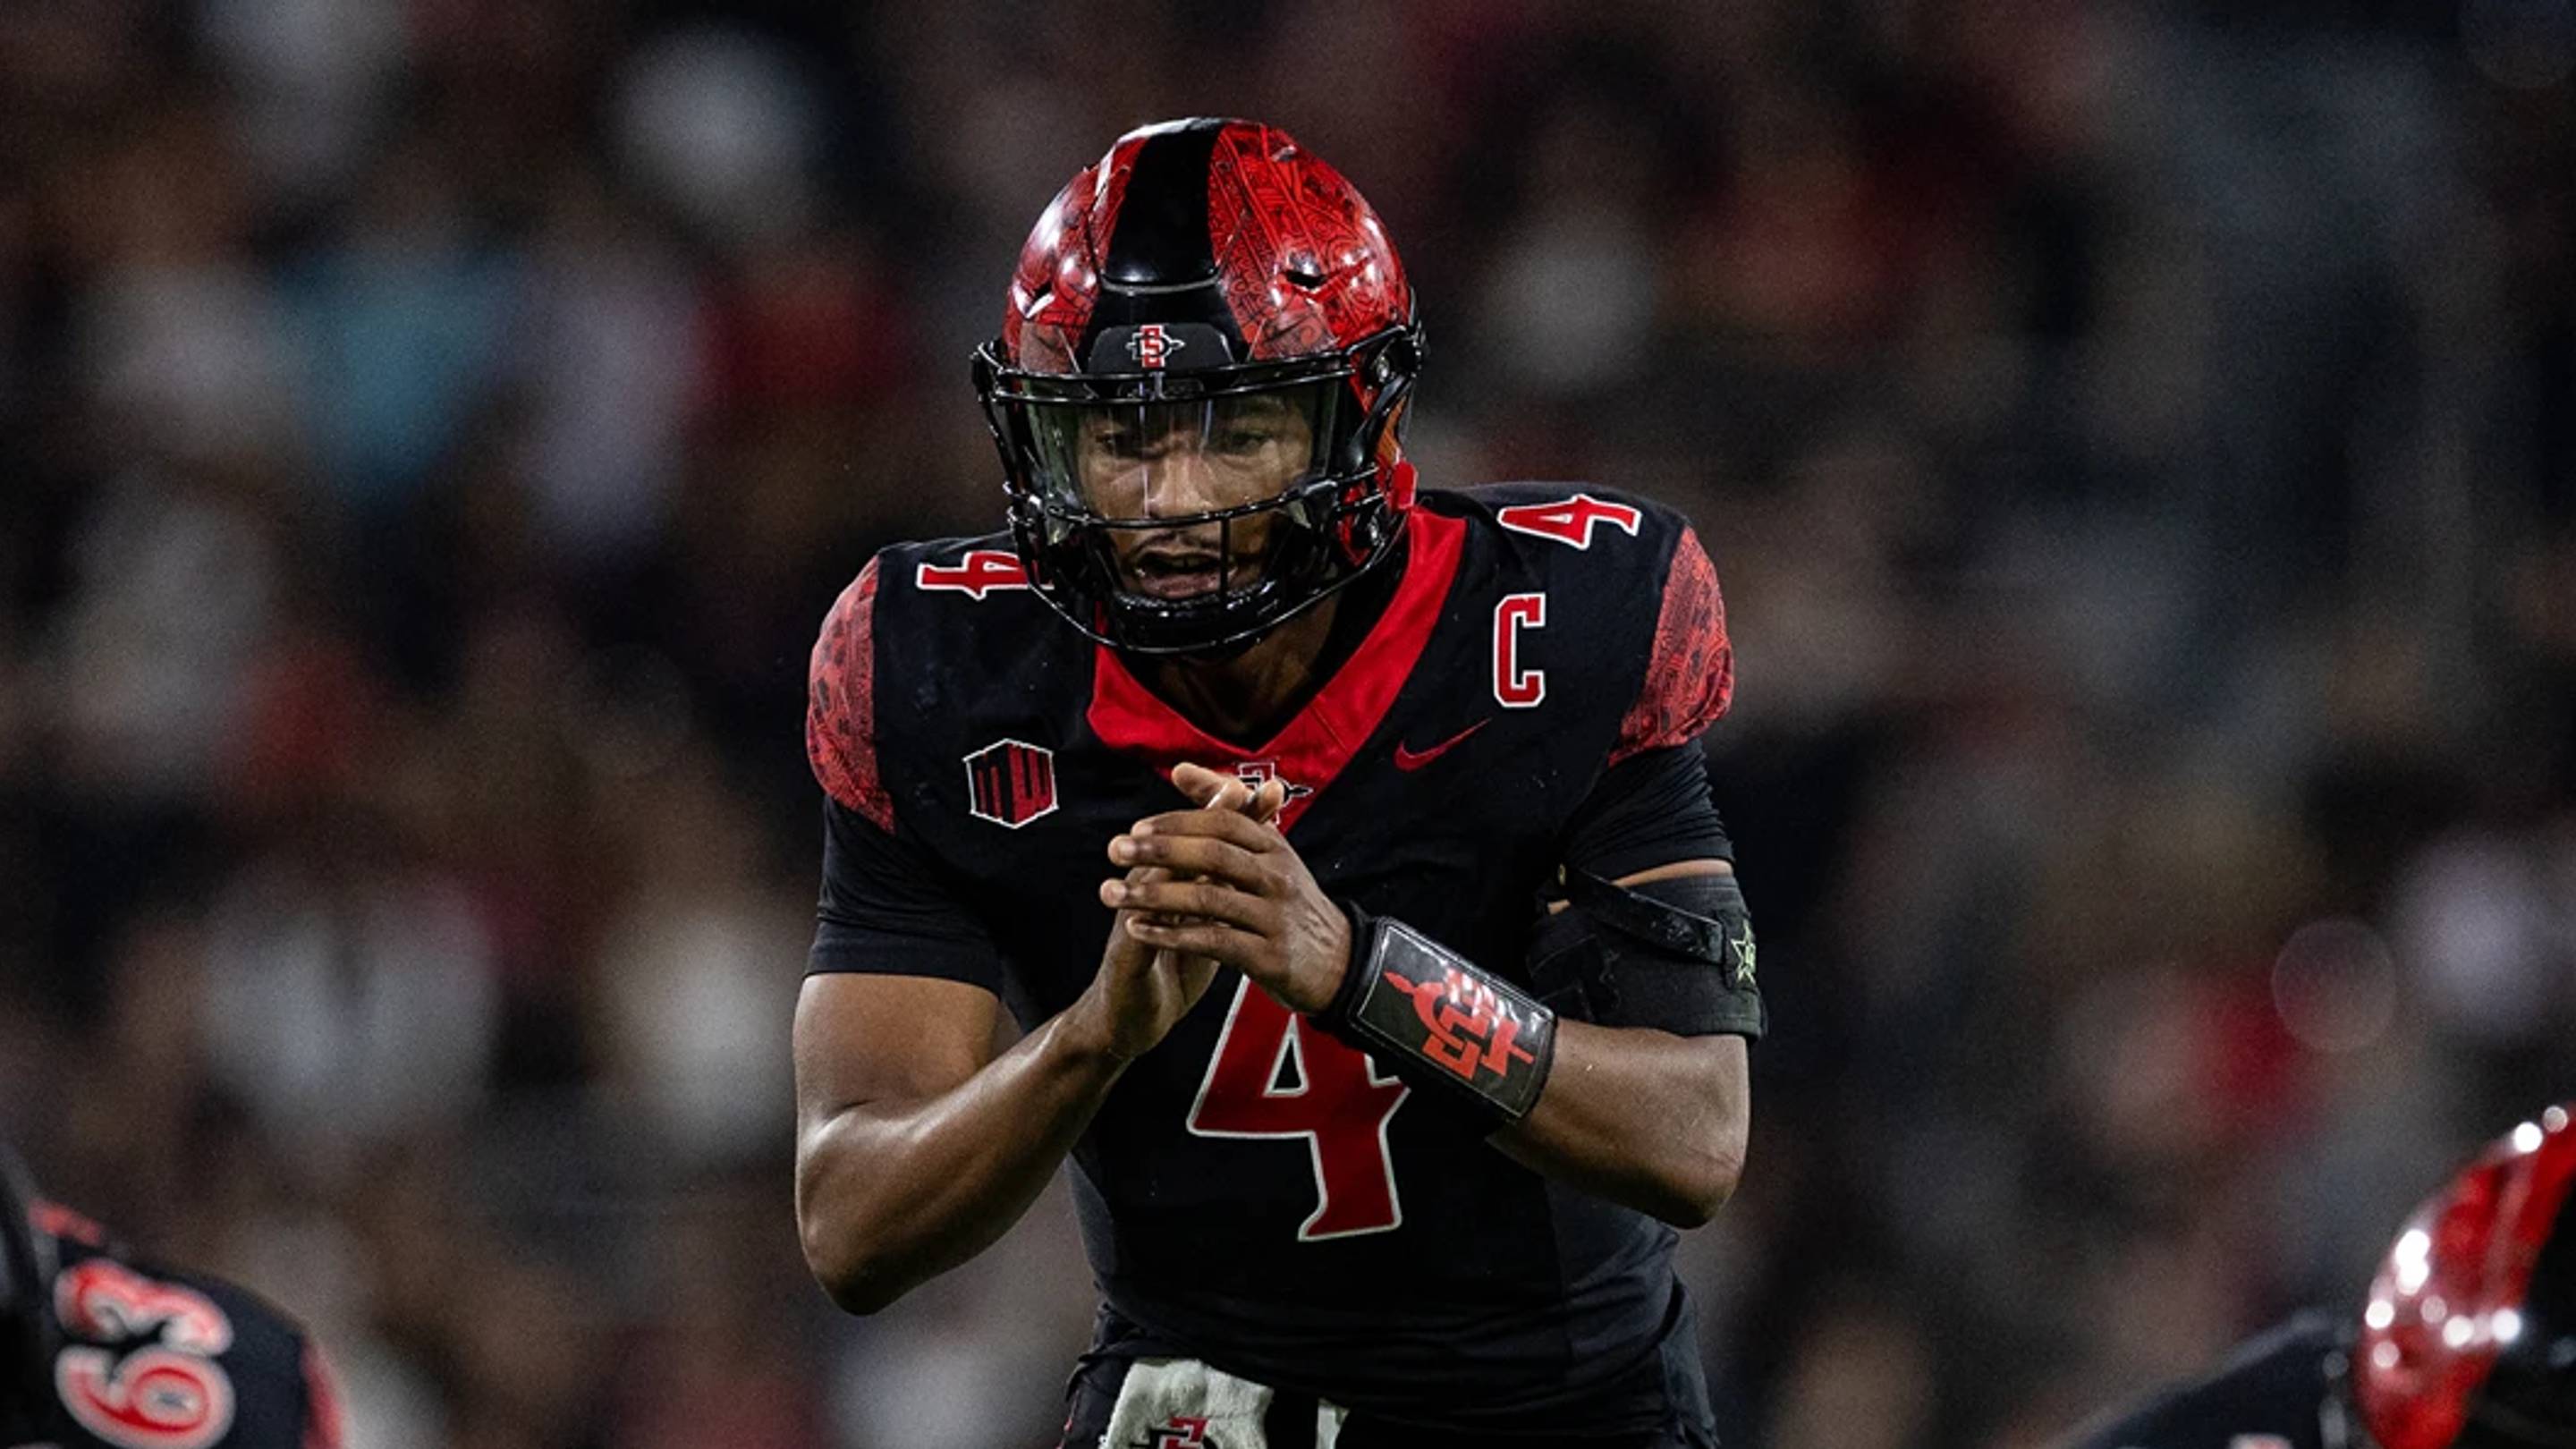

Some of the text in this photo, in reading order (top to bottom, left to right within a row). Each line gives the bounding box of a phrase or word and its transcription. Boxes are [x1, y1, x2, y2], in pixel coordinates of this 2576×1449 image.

[916, 548, 1055, 601] 4
[1496, 493, 1641, 550] 4
[1493, 592, 1546, 708] C
[1186, 972, 1411, 1242] 4
[53, 1257, 236, 1449] 63
